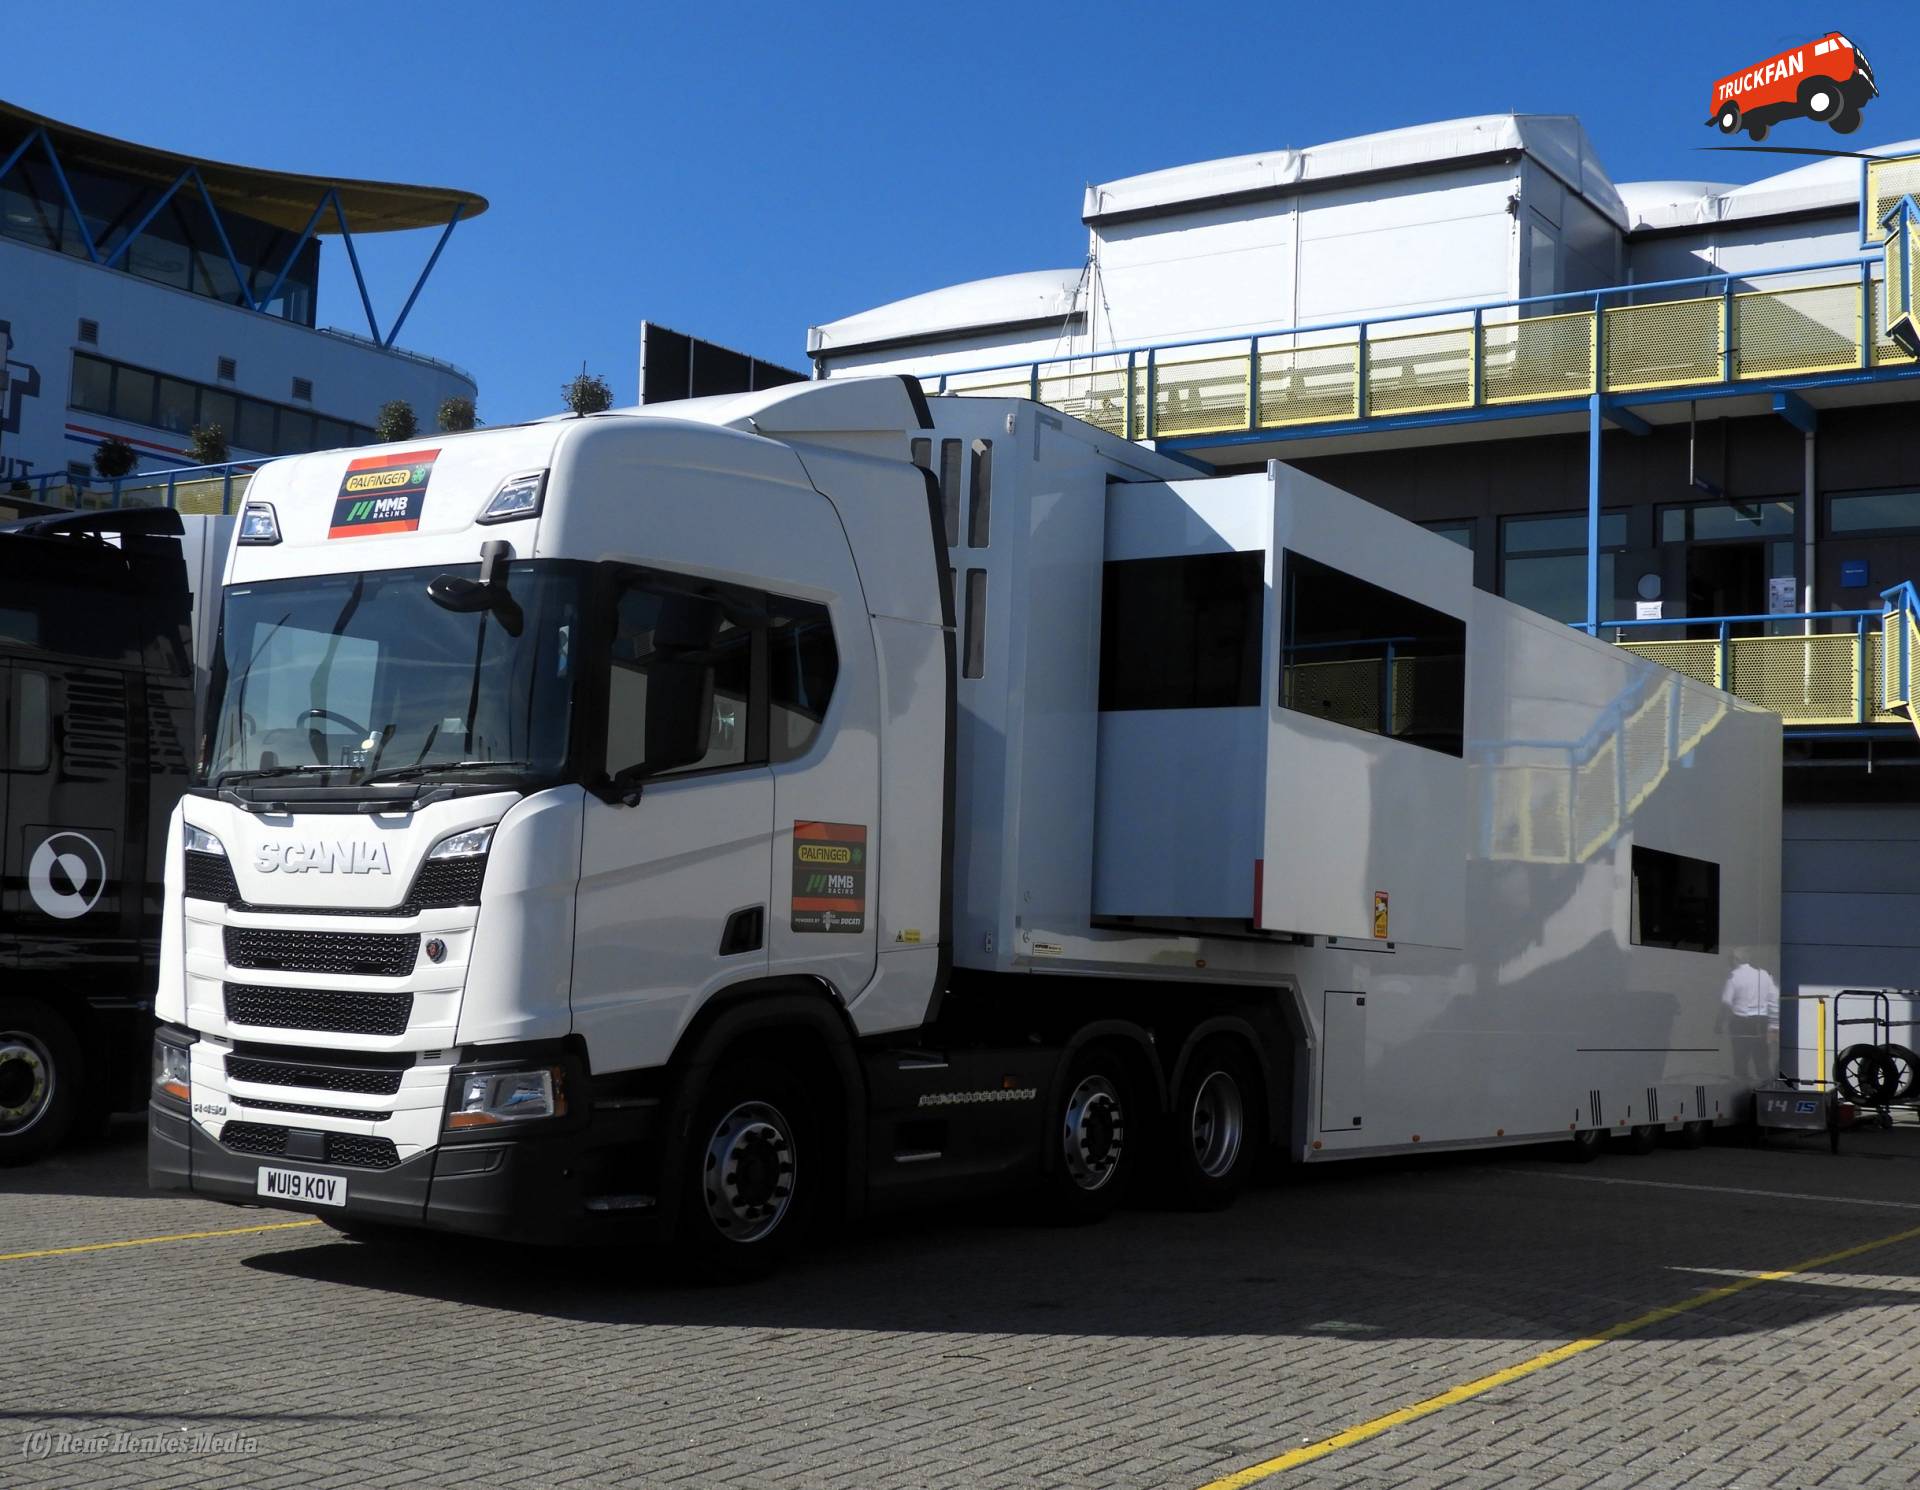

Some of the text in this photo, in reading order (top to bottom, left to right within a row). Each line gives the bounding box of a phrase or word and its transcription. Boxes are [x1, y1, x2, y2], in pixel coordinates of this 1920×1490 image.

[349, 471, 407, 489] PALFINGER
[374, 496, 408, 513] MMB
[373, 510, 406, 519] RACING
[254, 841, 391, 875] SCANIA
[801, 847, 848, 861] PALFINGER
[828, 874, 854, 888] MMB
[1768, 1100, 1788, 1112] 14
[267, 1171, 337, 1201] WU19 KOV
